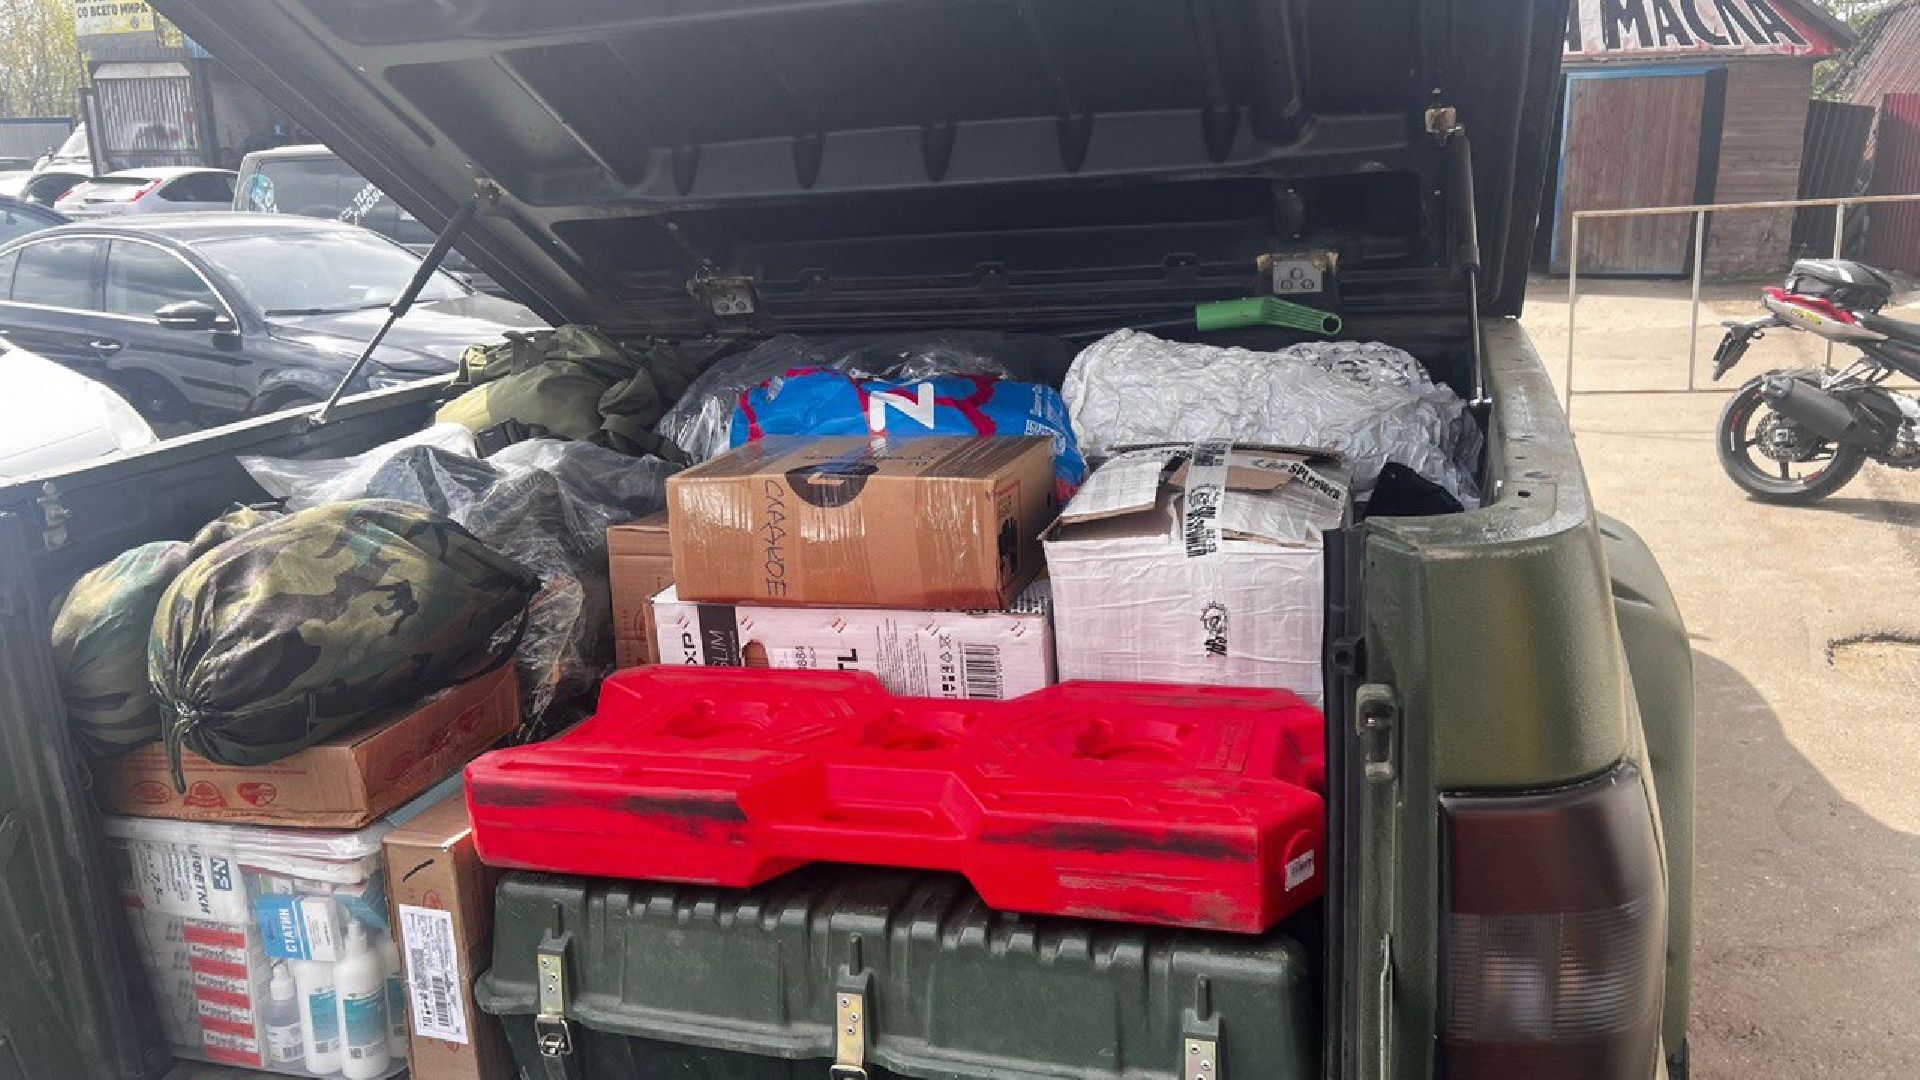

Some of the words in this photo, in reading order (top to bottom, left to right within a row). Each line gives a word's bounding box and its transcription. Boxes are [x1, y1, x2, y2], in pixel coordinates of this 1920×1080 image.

[77, 6, 89, 18] СО
[90, 3, 118, 17] ВСЕГО
[119, 2, 149, 15] МИРА
[1603, 0, 1808, 50] МАСЛА
[760, 479, 787, 598] СЛАДКОЕ
[708, 629, 729, 667] SLIM
